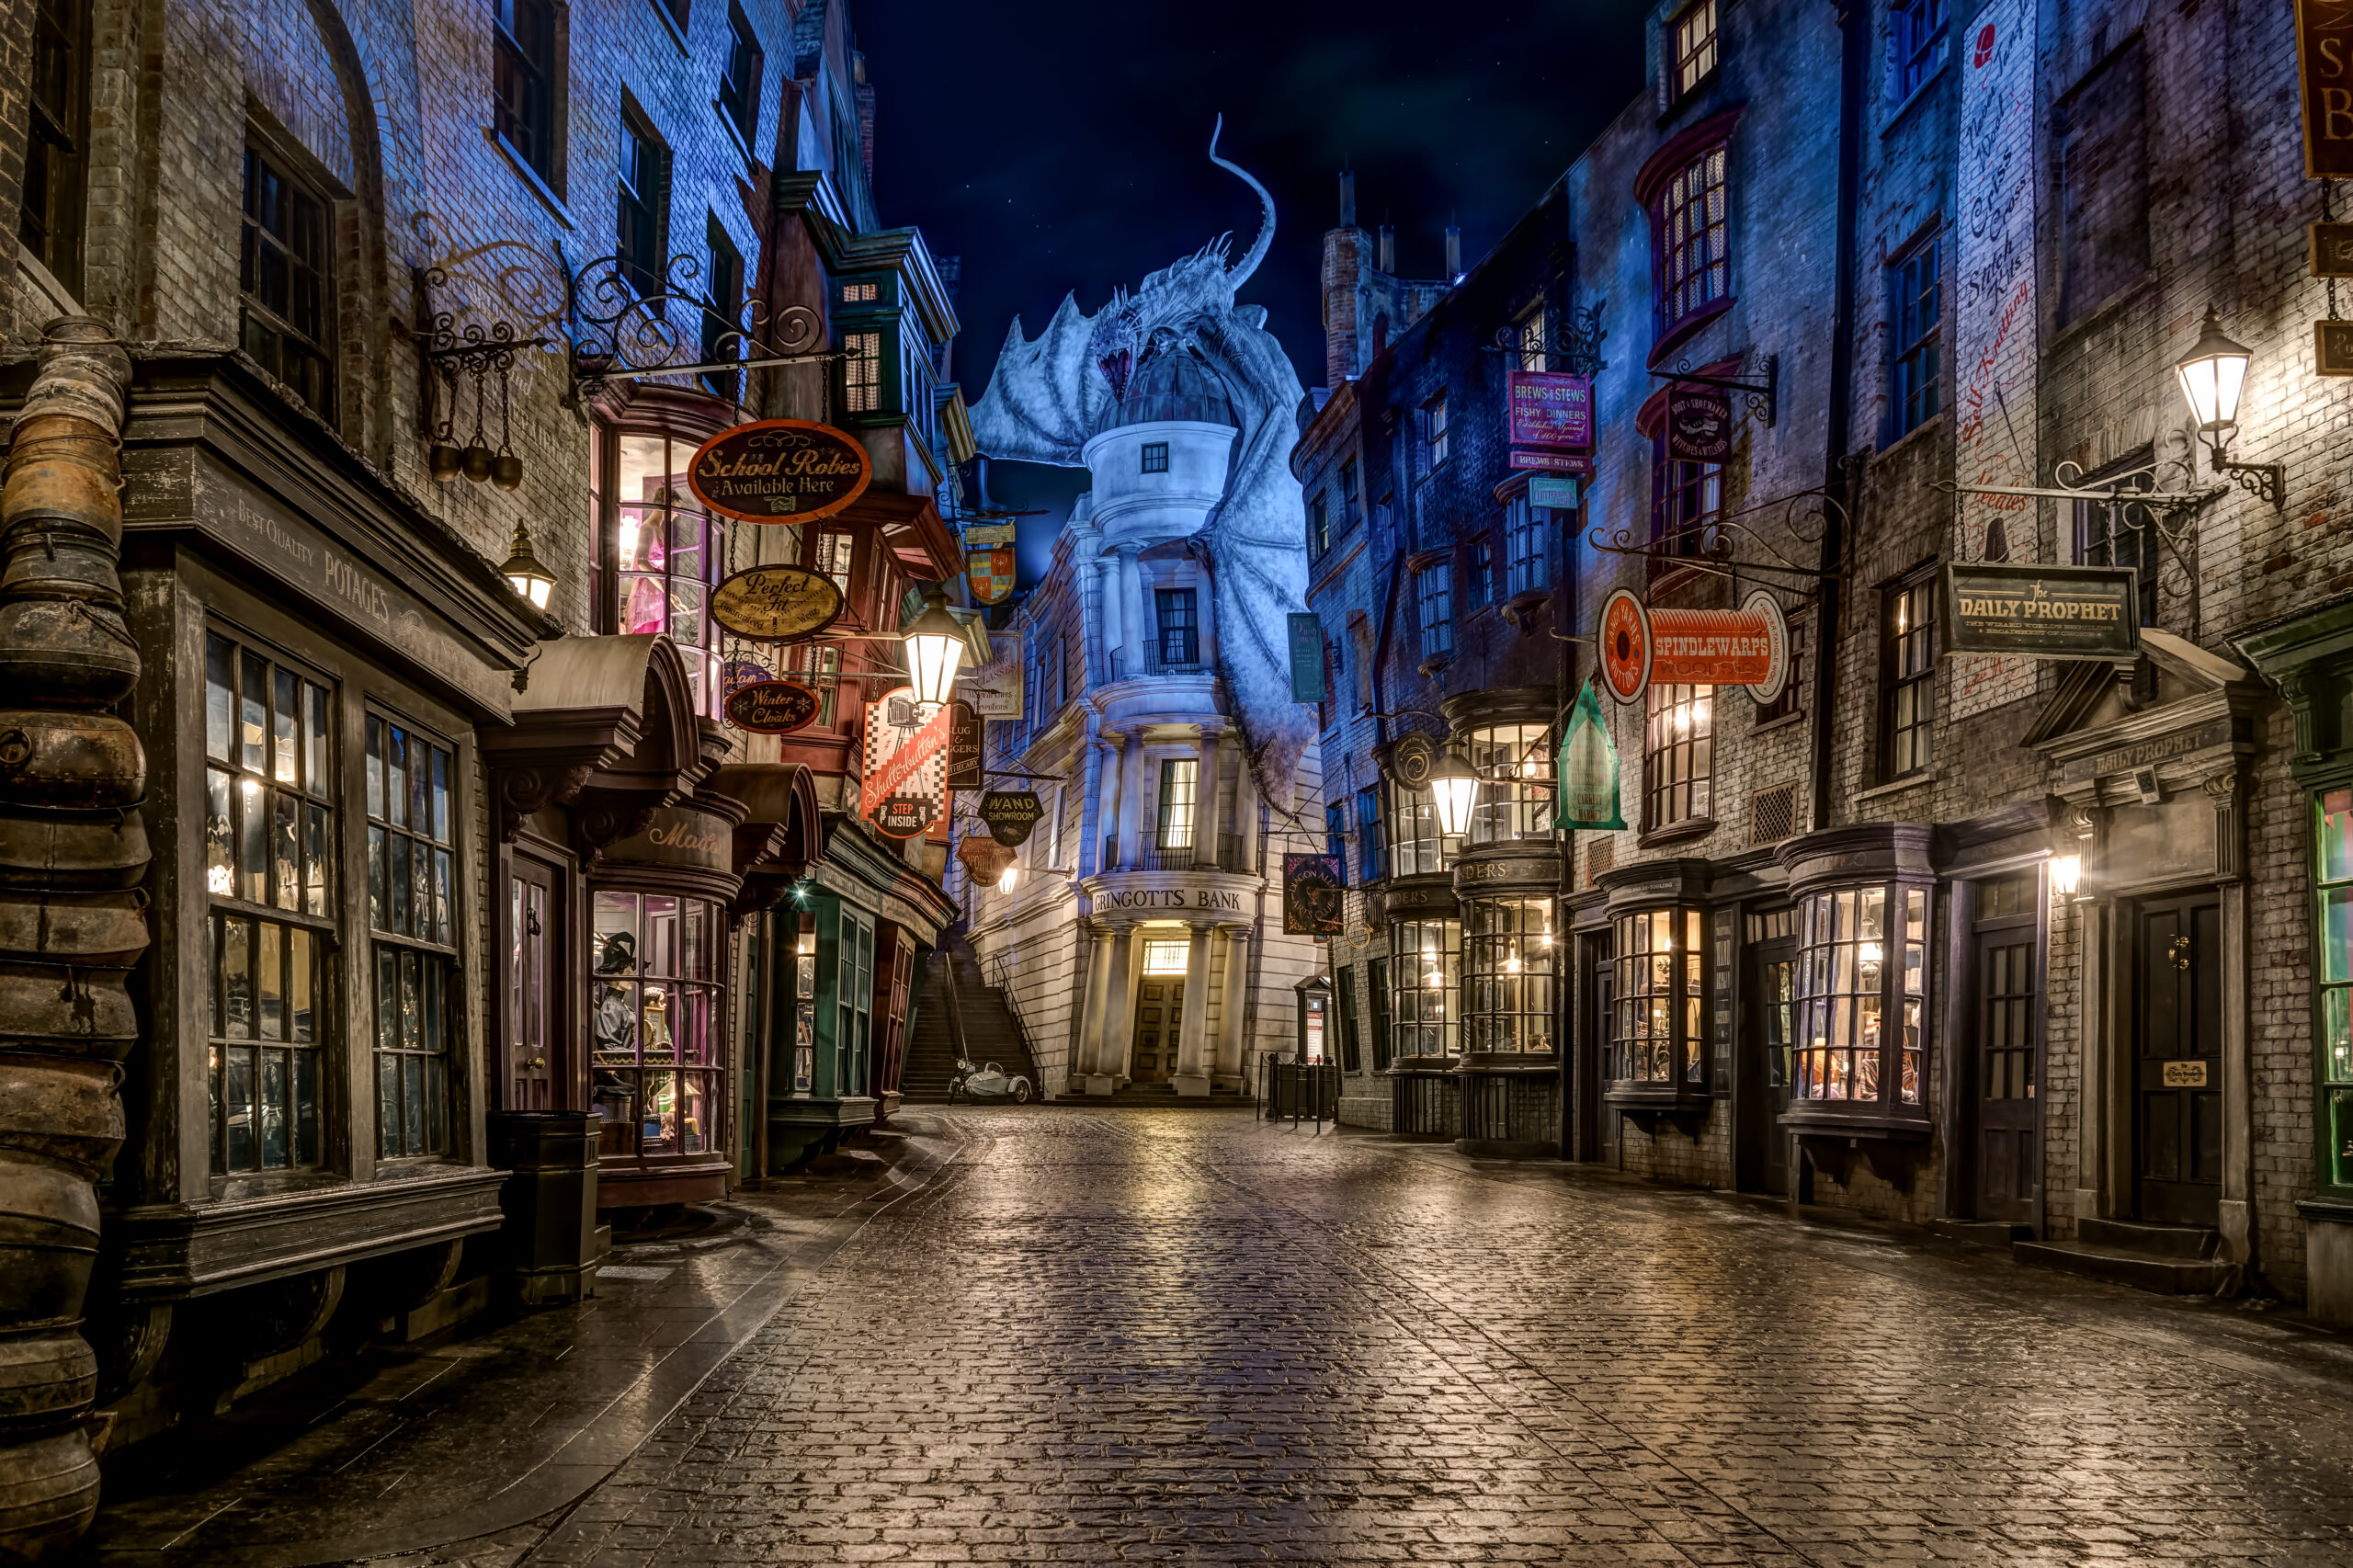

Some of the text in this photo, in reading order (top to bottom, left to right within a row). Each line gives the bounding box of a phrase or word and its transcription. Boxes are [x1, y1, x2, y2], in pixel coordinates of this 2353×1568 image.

[1990, 176, 2027, 242] Cross
[1987, 256, 2022, 316] Kits
[1962, 279, 2028, 448] Self Knitting
[1515, 385, 1547, 400] BREWS
[1555, 388, 1586, 403] STEWS
[1515, 407, 1586, 420] FISHY DINNERS
[699, 449, 860, 476] School Robes
[1519, 455, 1550, 465] BREWS
[1554, 458, 1584, 468] STEWS
[722, 477, 834, 496] Available Here
[238, 498, 314, 566] BEST QUALITY
[744, 573, 811, 596] Perfect
[2029, 579, 2048, 602] The
[763, 593, 790, 612] Fit
[1959, 598, 2121, 620] DAILY PROPHET
[720, 601, 818, 631] Guaranteed Wear
[1608, 604, 1641, 646] FANCY YARNS
[1761, 606, 1779, 663] NEVER-TANGLE
[1655, 636, 1768, 656] SPINDLEWARPS
[1610, 658, 1640, 688] BUTTONS
[752, 688, 794, 706] Winter
[752, 707, 796, 723] Cloaks
[949, 744, 978, 753] GGERS
[954, 735, 963, 744] &
[2096, 730, 2202, 774] DAILY PROPHET
[865, 726, 947, 808] Shutterbutton's
[892, 803, 914, 815] STEP
[988, 798, 1035, 810] WAND
[888, 816, 917, 827] INSIDE
[988, 812, 1034, 821] SHOWROOM
[1289, 870, 1317, 892] DIAGON
[1465, 862, 1506, 880] DERS
[1095, 889, 1240, 912] GRINGOTTS BANK
[1390, 890, 1427, 905] NDERS
[1293, 900, 1313, 919] ARTS
